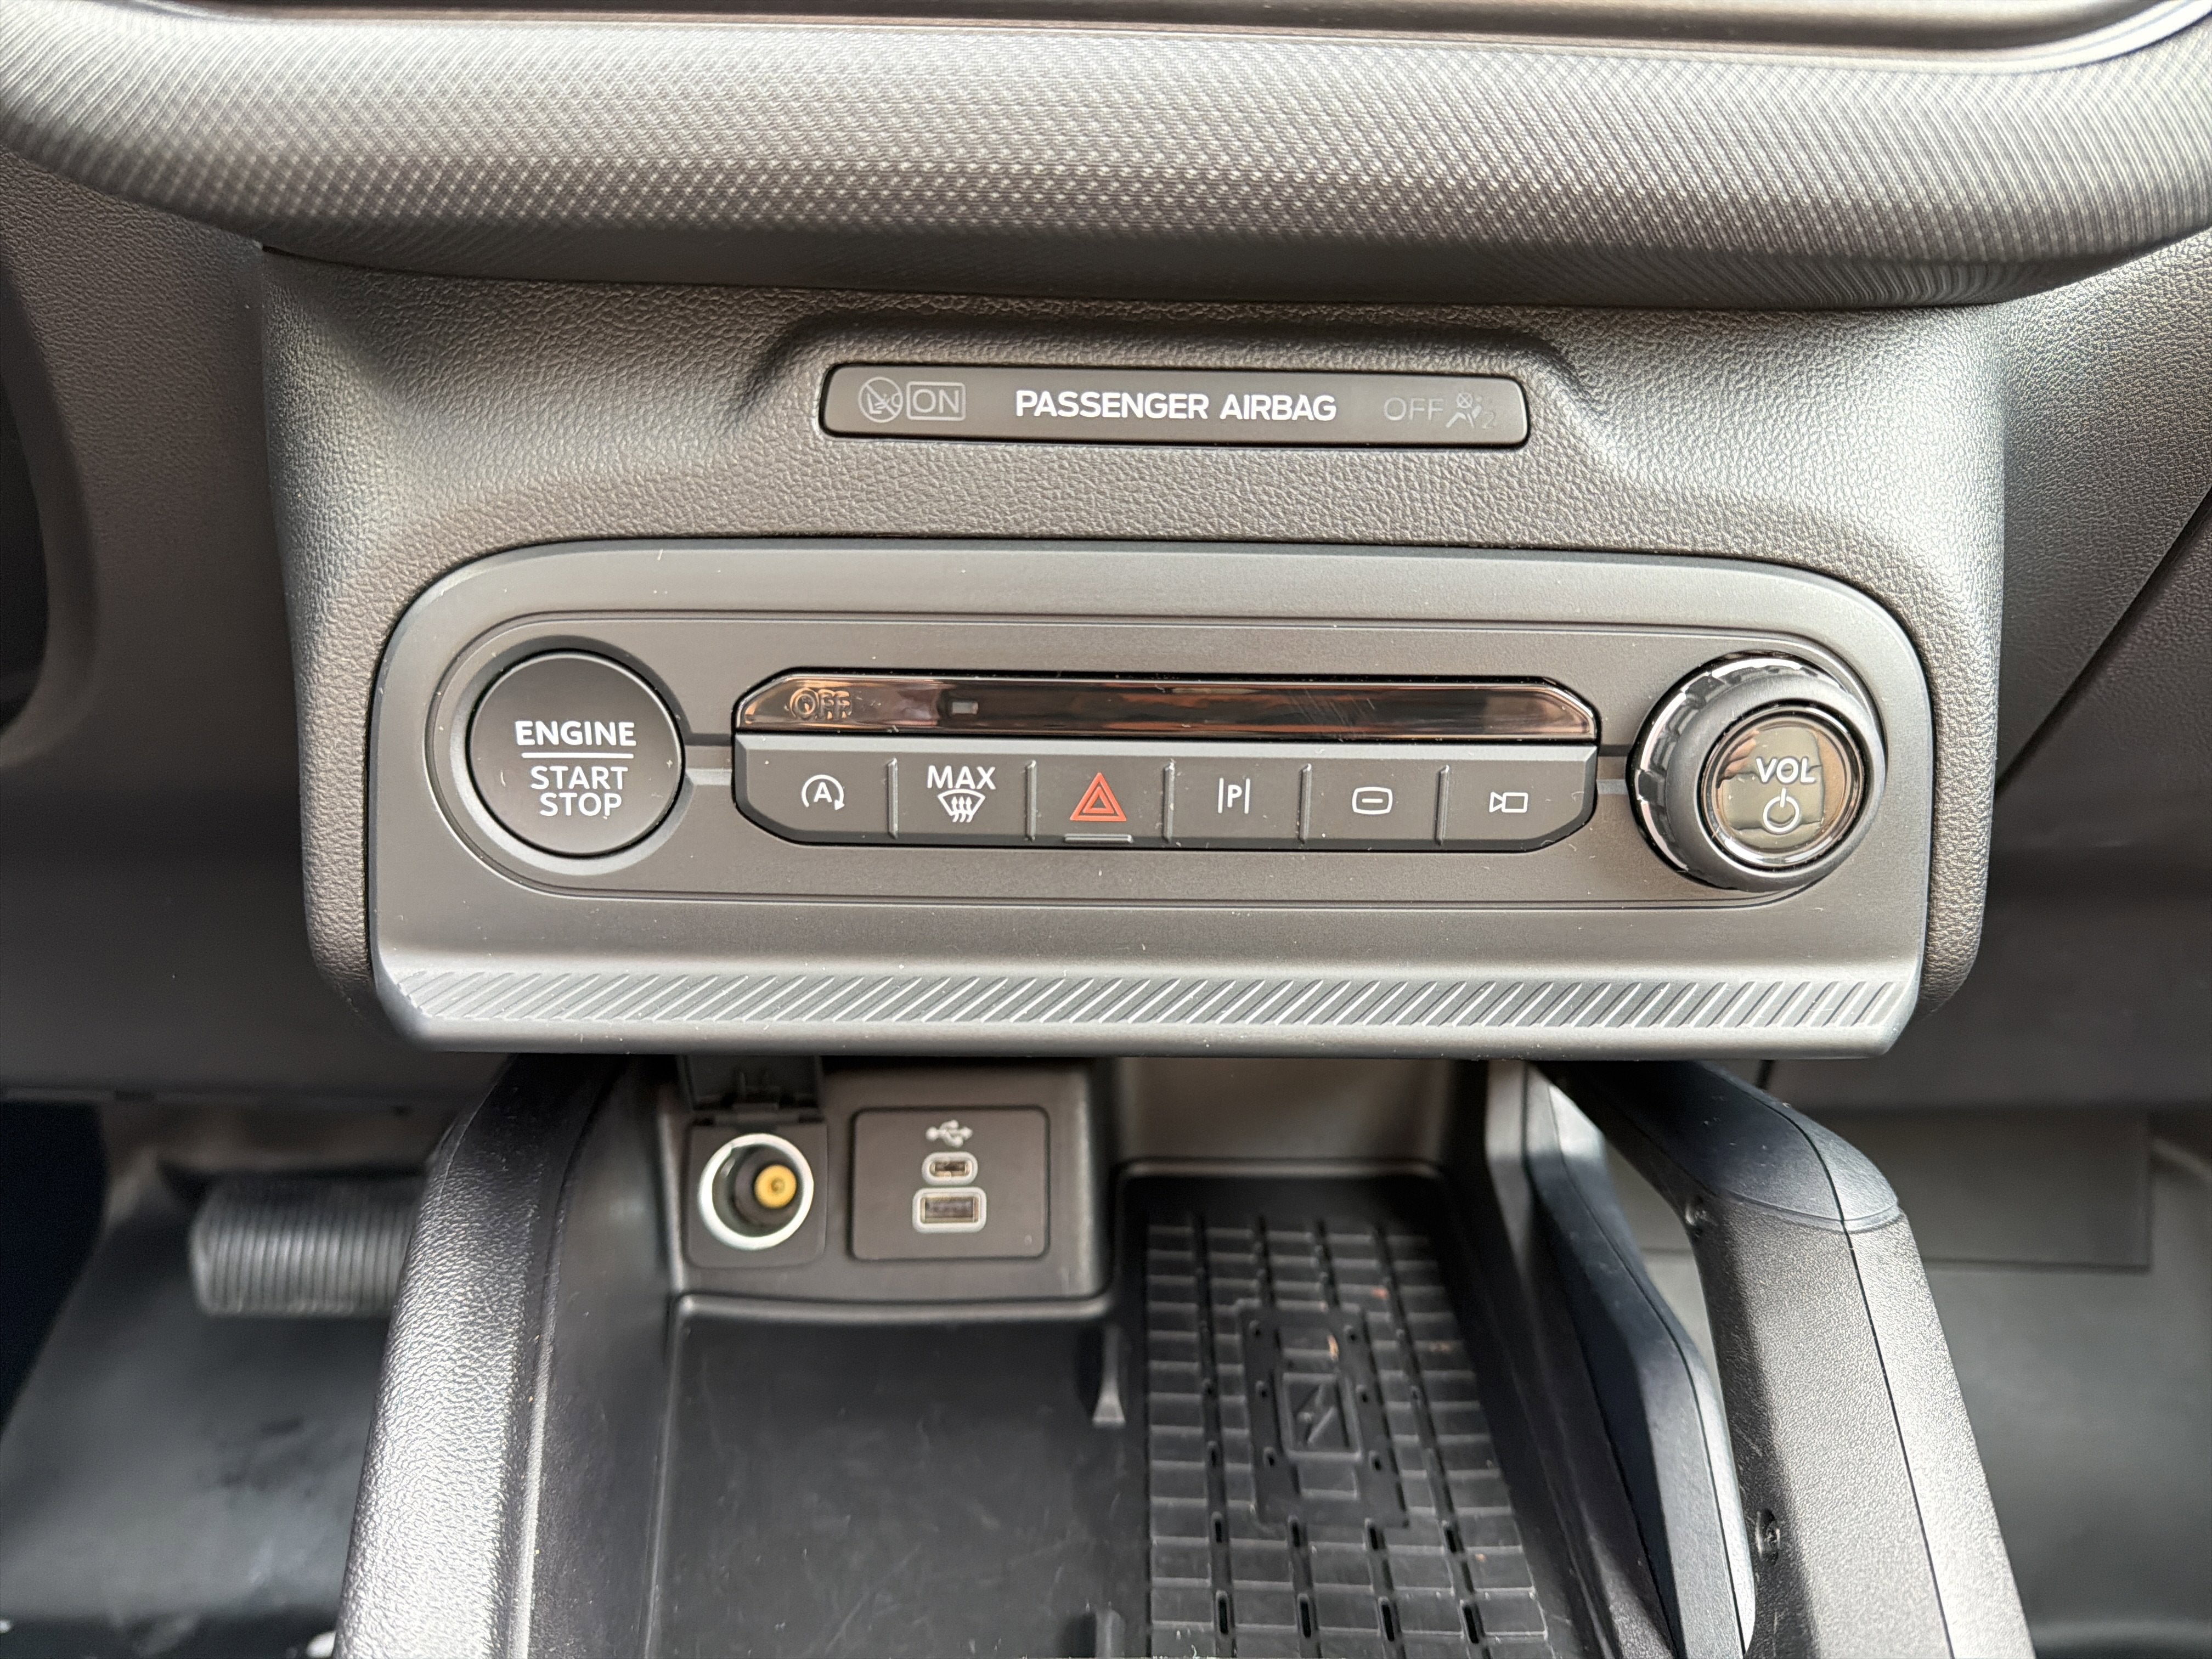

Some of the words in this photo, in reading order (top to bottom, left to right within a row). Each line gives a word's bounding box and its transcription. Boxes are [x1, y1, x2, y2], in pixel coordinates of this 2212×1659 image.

[912, 388, 960, 414] ON
[1015, 390, 1209, 419] PASSENGER
[1219, 393, 1336, 421] AIRBAG
[1383, 397, 1444, 421] OFF
[514, 720, 637, 746] ENGINE
[530, 765, 629, 790] START
[927, 765, 996, 791] MAX
[1756, 756, 1815, 784] VOL
[539, 792, 623, 817] STOP
